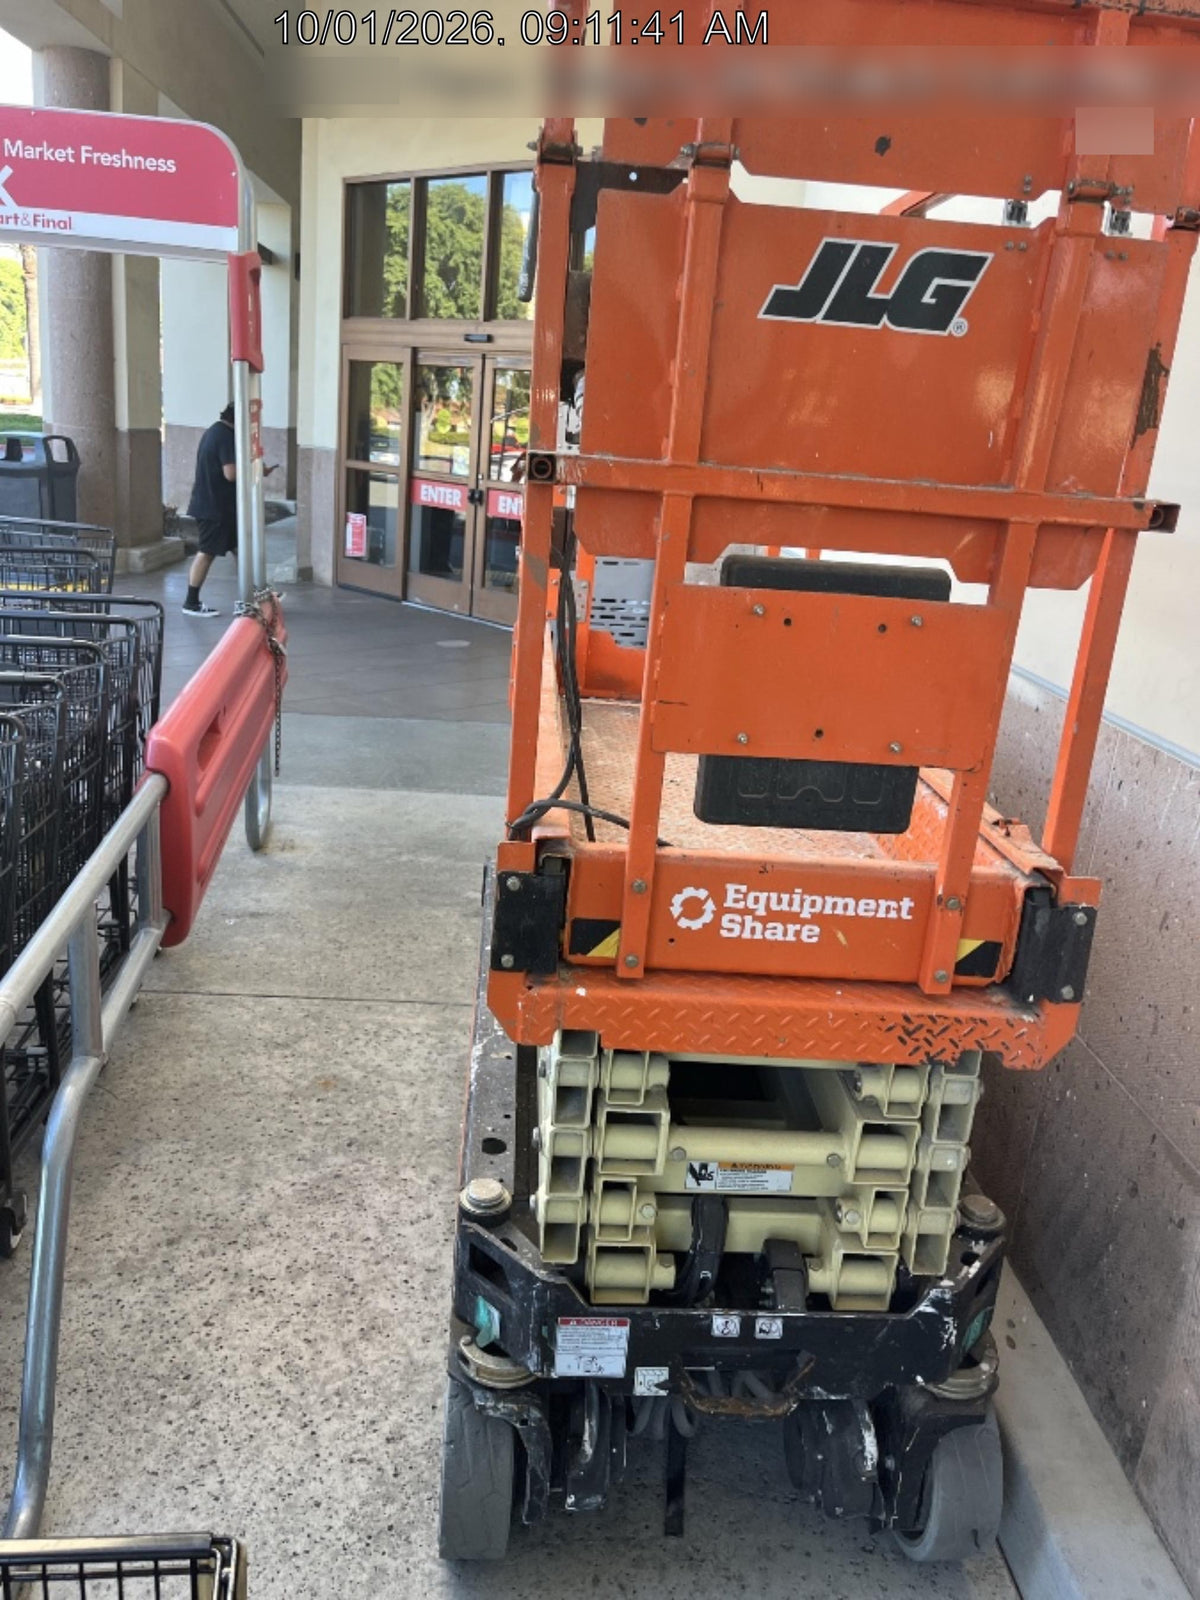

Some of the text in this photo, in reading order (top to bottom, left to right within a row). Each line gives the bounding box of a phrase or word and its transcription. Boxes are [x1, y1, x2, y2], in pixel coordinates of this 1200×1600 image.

[4, 138, 177, 173] Market Freshness
[420, 484, 462, 506] ENTER
[724, 883, 914, 919] Equipment
[720, 914, 820, 943] Share
